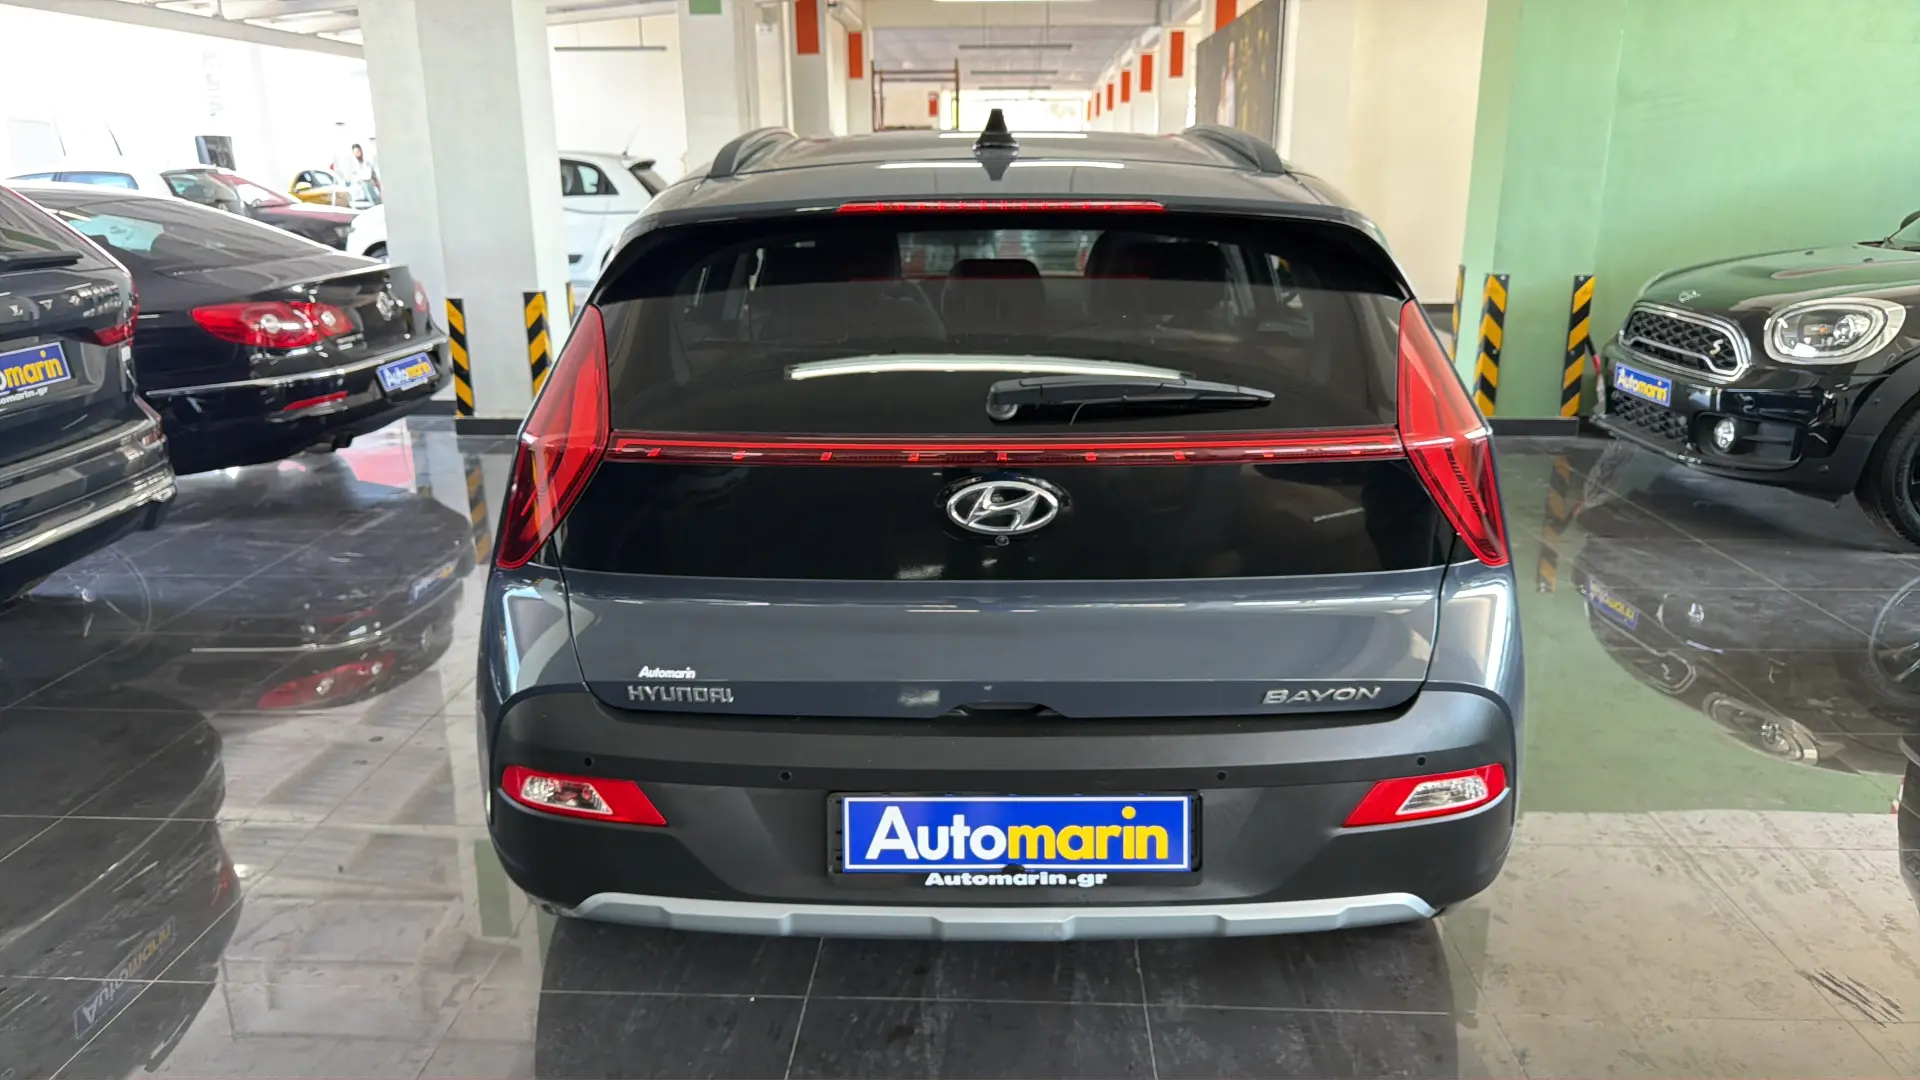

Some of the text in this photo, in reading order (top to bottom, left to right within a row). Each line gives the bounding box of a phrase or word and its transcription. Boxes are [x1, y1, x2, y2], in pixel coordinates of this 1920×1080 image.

[1617, 367, 1667, 402] Automarin
[638, 666, 696, 679] Automarin
[627, 684, 734, 703] HYUNDAI
[1262, 686, 1381, 704] BAYON
[865, 805, 1169, 861] Automarin
[925, 872, 1108, 888] Automarin.gr
